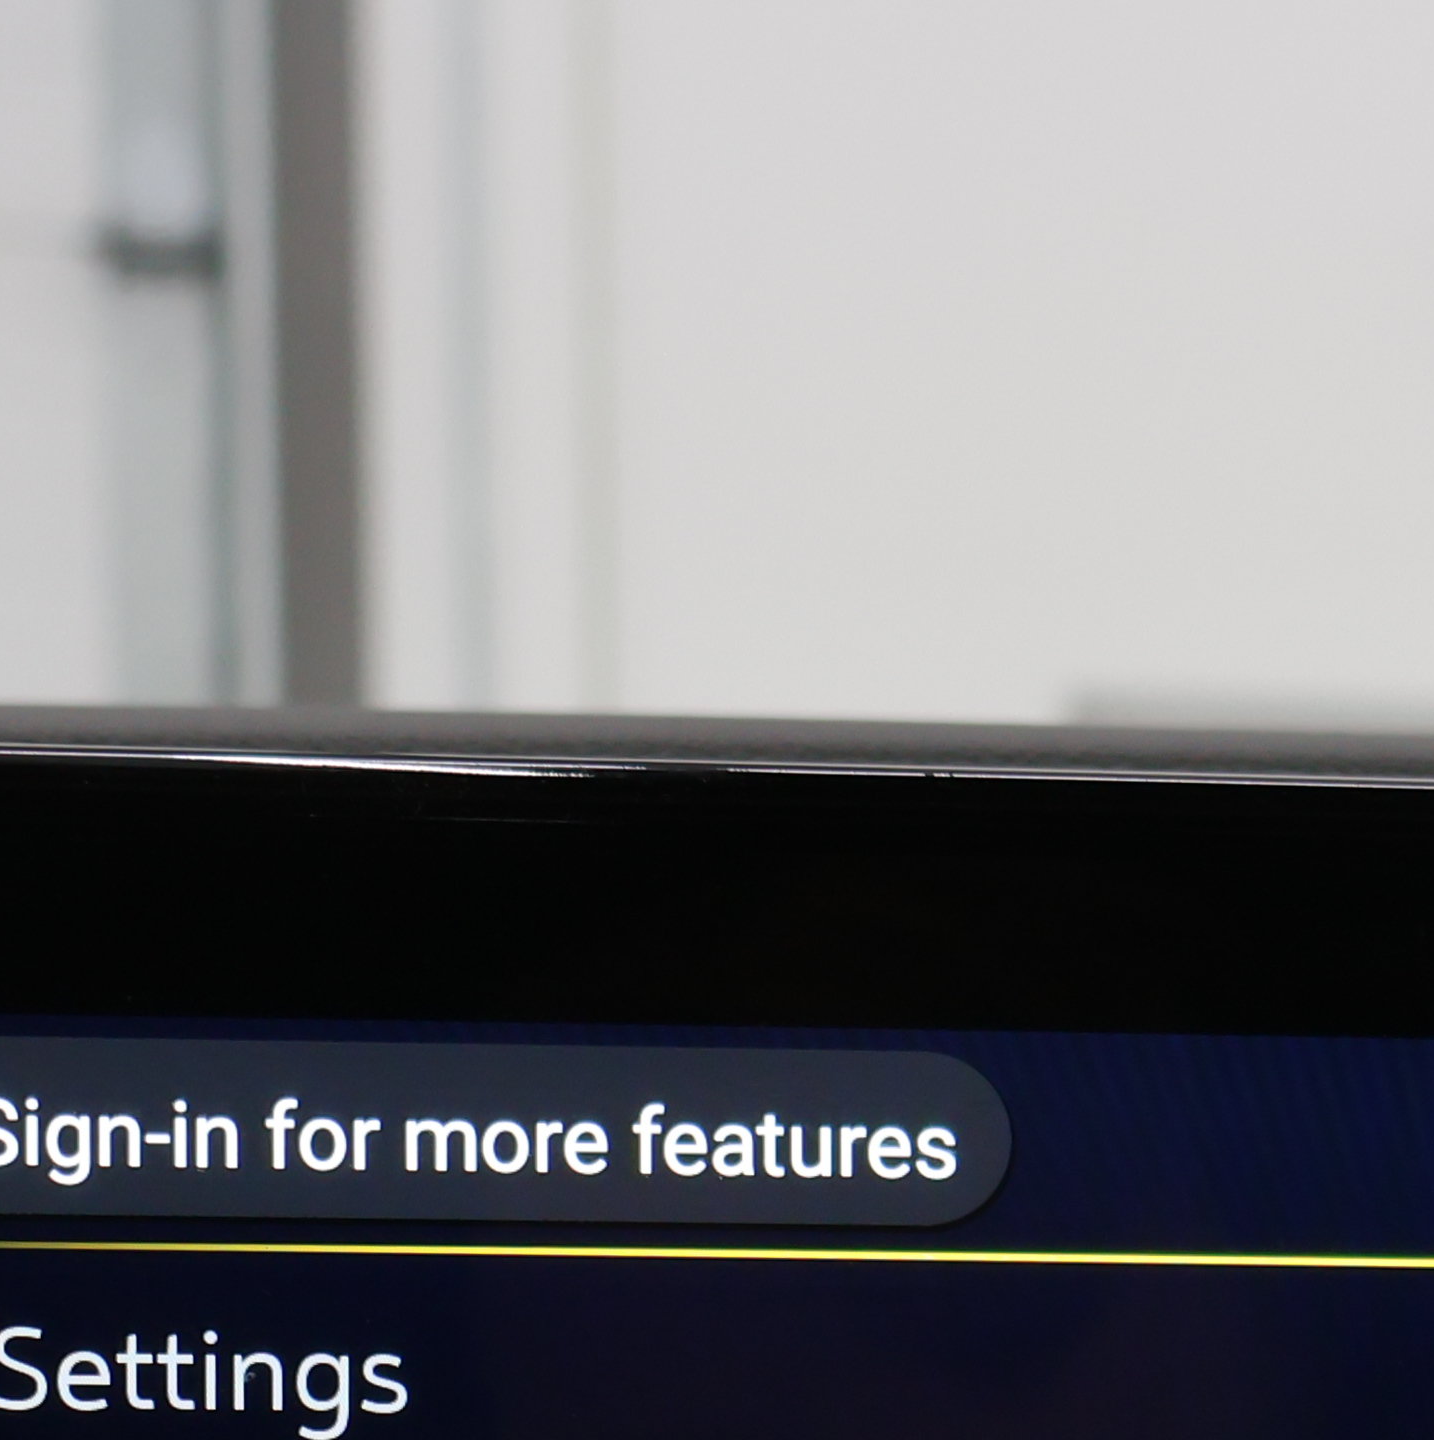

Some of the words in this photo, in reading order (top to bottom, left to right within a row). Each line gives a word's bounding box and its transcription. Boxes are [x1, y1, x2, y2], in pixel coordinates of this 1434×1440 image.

[265, 1096, 382, 1173] for
[405, 1118, 609, 1178] more
[632, 1105, 958, 1182] features
